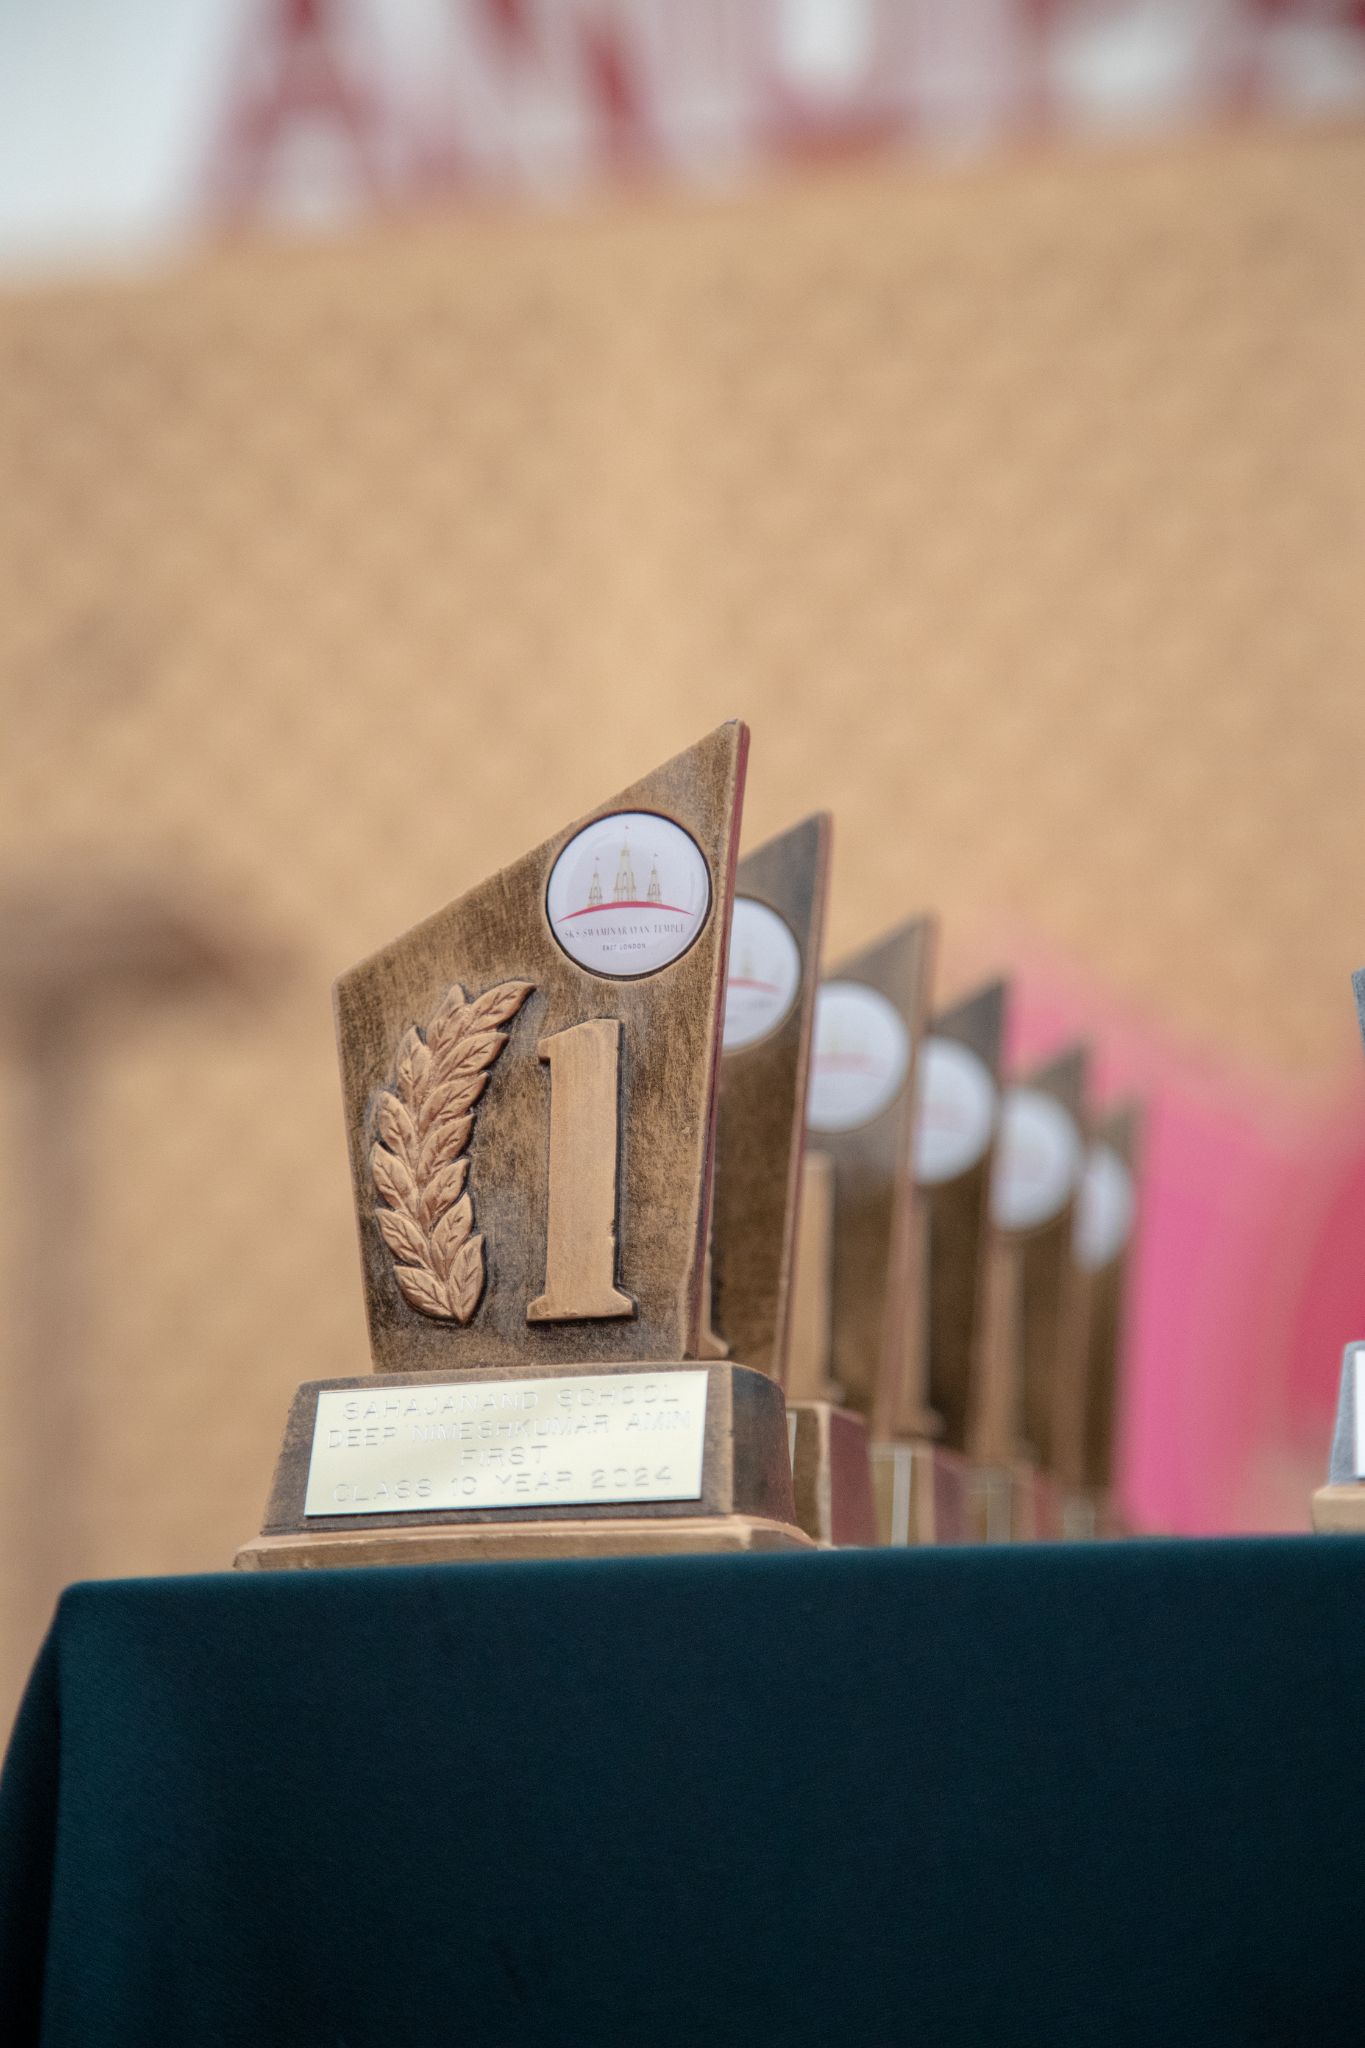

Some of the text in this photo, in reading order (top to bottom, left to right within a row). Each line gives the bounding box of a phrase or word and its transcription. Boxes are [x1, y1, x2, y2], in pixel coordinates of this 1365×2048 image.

[602, 942, 646, 952] EAST LONDON
[653, 923, 686, 934] TEMPLE
[527, 1017, 637, 1321] 1
[343, 1384, 680, 1421] SAHAJANAND SCHOOL
[328, 1410, 691, 1449] DEEP NIMESHKUMAR AMIN
[461, 1445, 548, 1466] FIRST
[334, 1465, 673, 1502] CLASS 10 YEAR 2024
